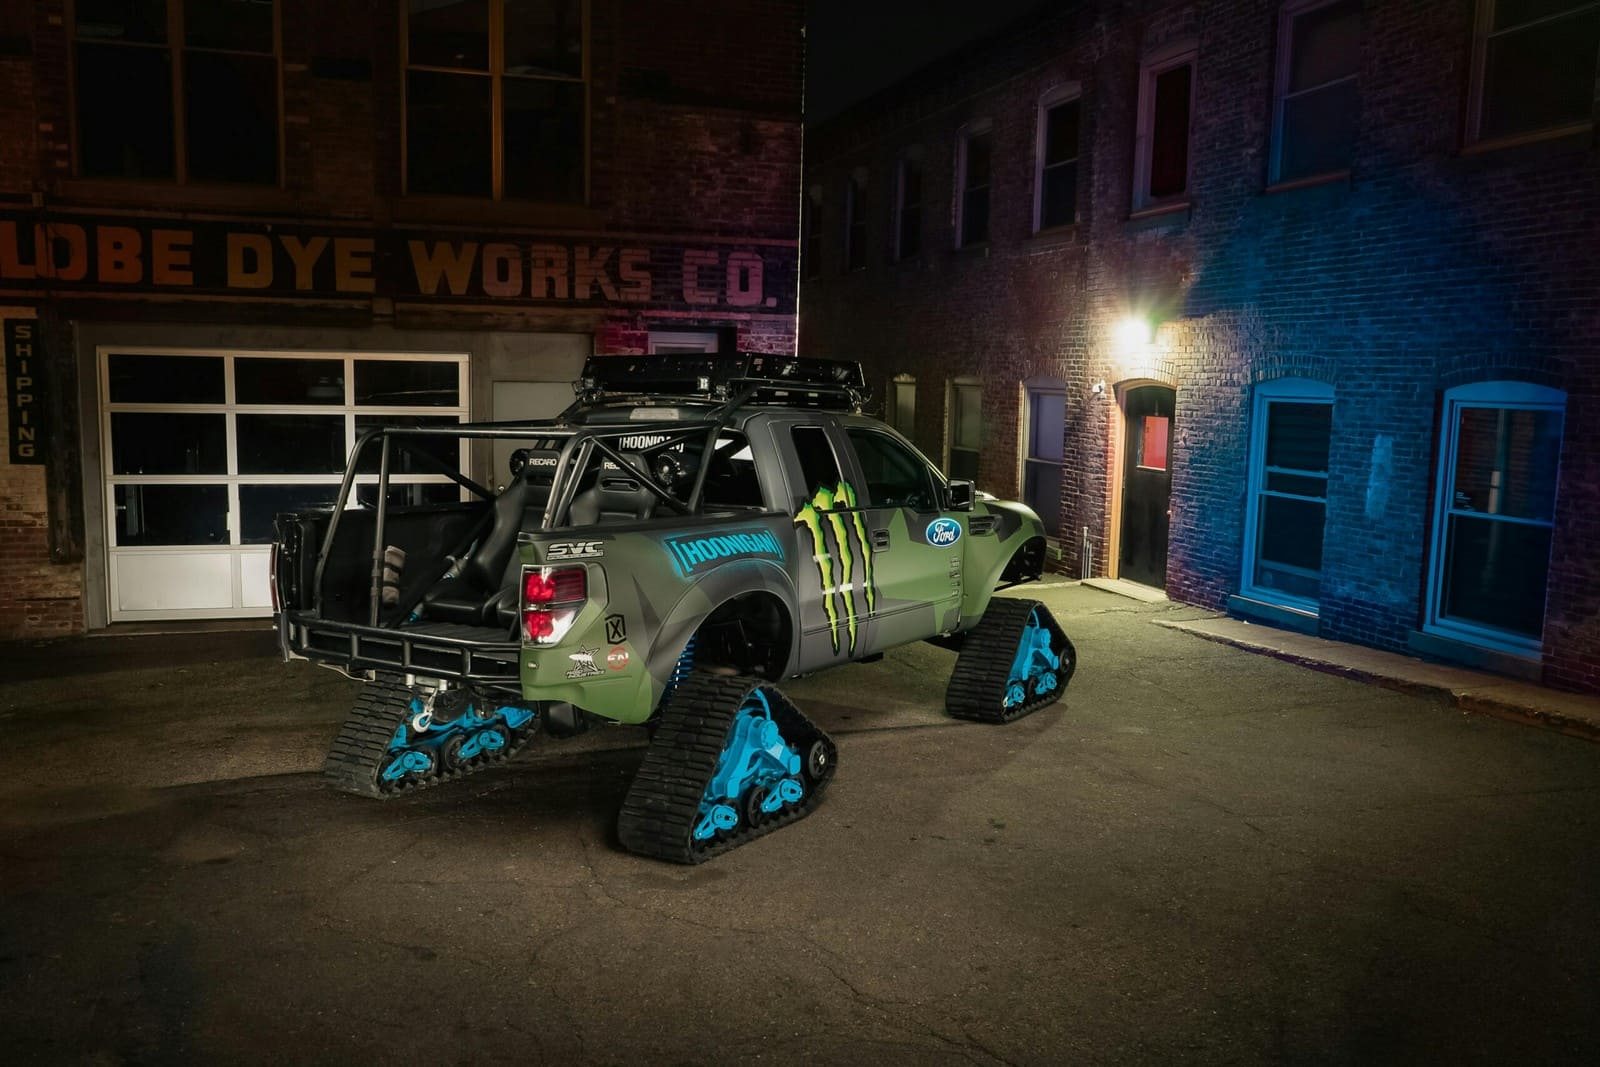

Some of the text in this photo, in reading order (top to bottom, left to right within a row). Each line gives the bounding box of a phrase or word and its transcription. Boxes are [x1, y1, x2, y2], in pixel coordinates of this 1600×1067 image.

[0, 219, 778, 308] LOBE DYE WORKS CO.
[15, 324, 35, 457] SHIPPING
[529, 458, 557, 467] RECARO
[933, 522, 956, 543] Ford
[547, 541, 604, 556] SVC
